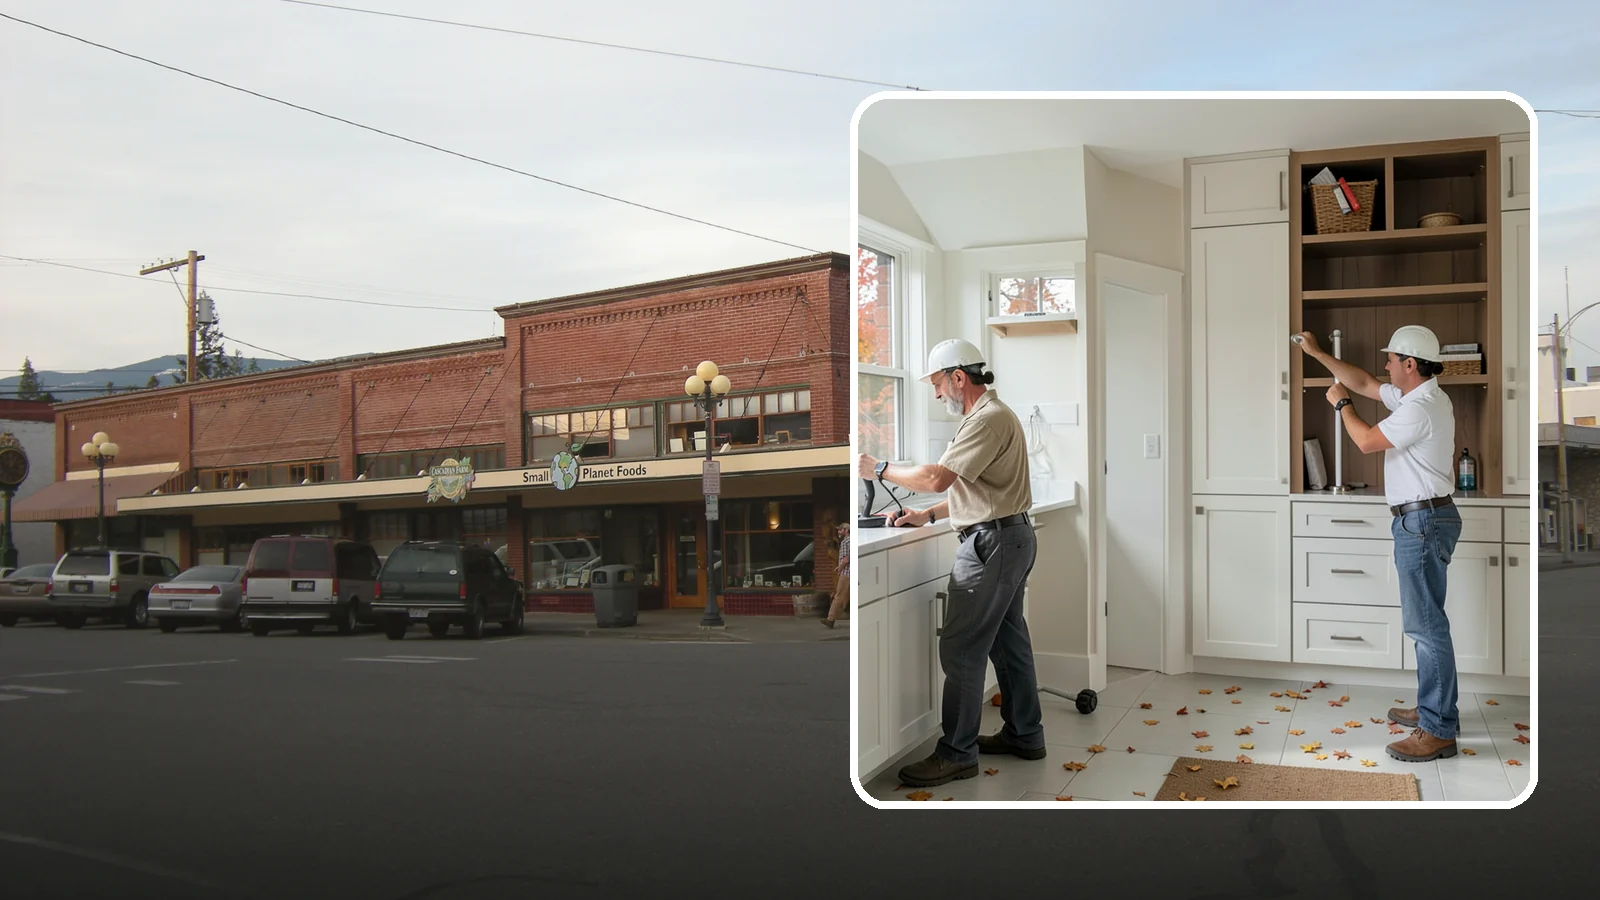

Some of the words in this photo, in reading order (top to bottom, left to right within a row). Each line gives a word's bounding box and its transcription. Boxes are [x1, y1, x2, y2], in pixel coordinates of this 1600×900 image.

[523, 471, 549, 482] Small
[583, 468, 614, 479] Planet
[617, 464, 647, 476] Foods
